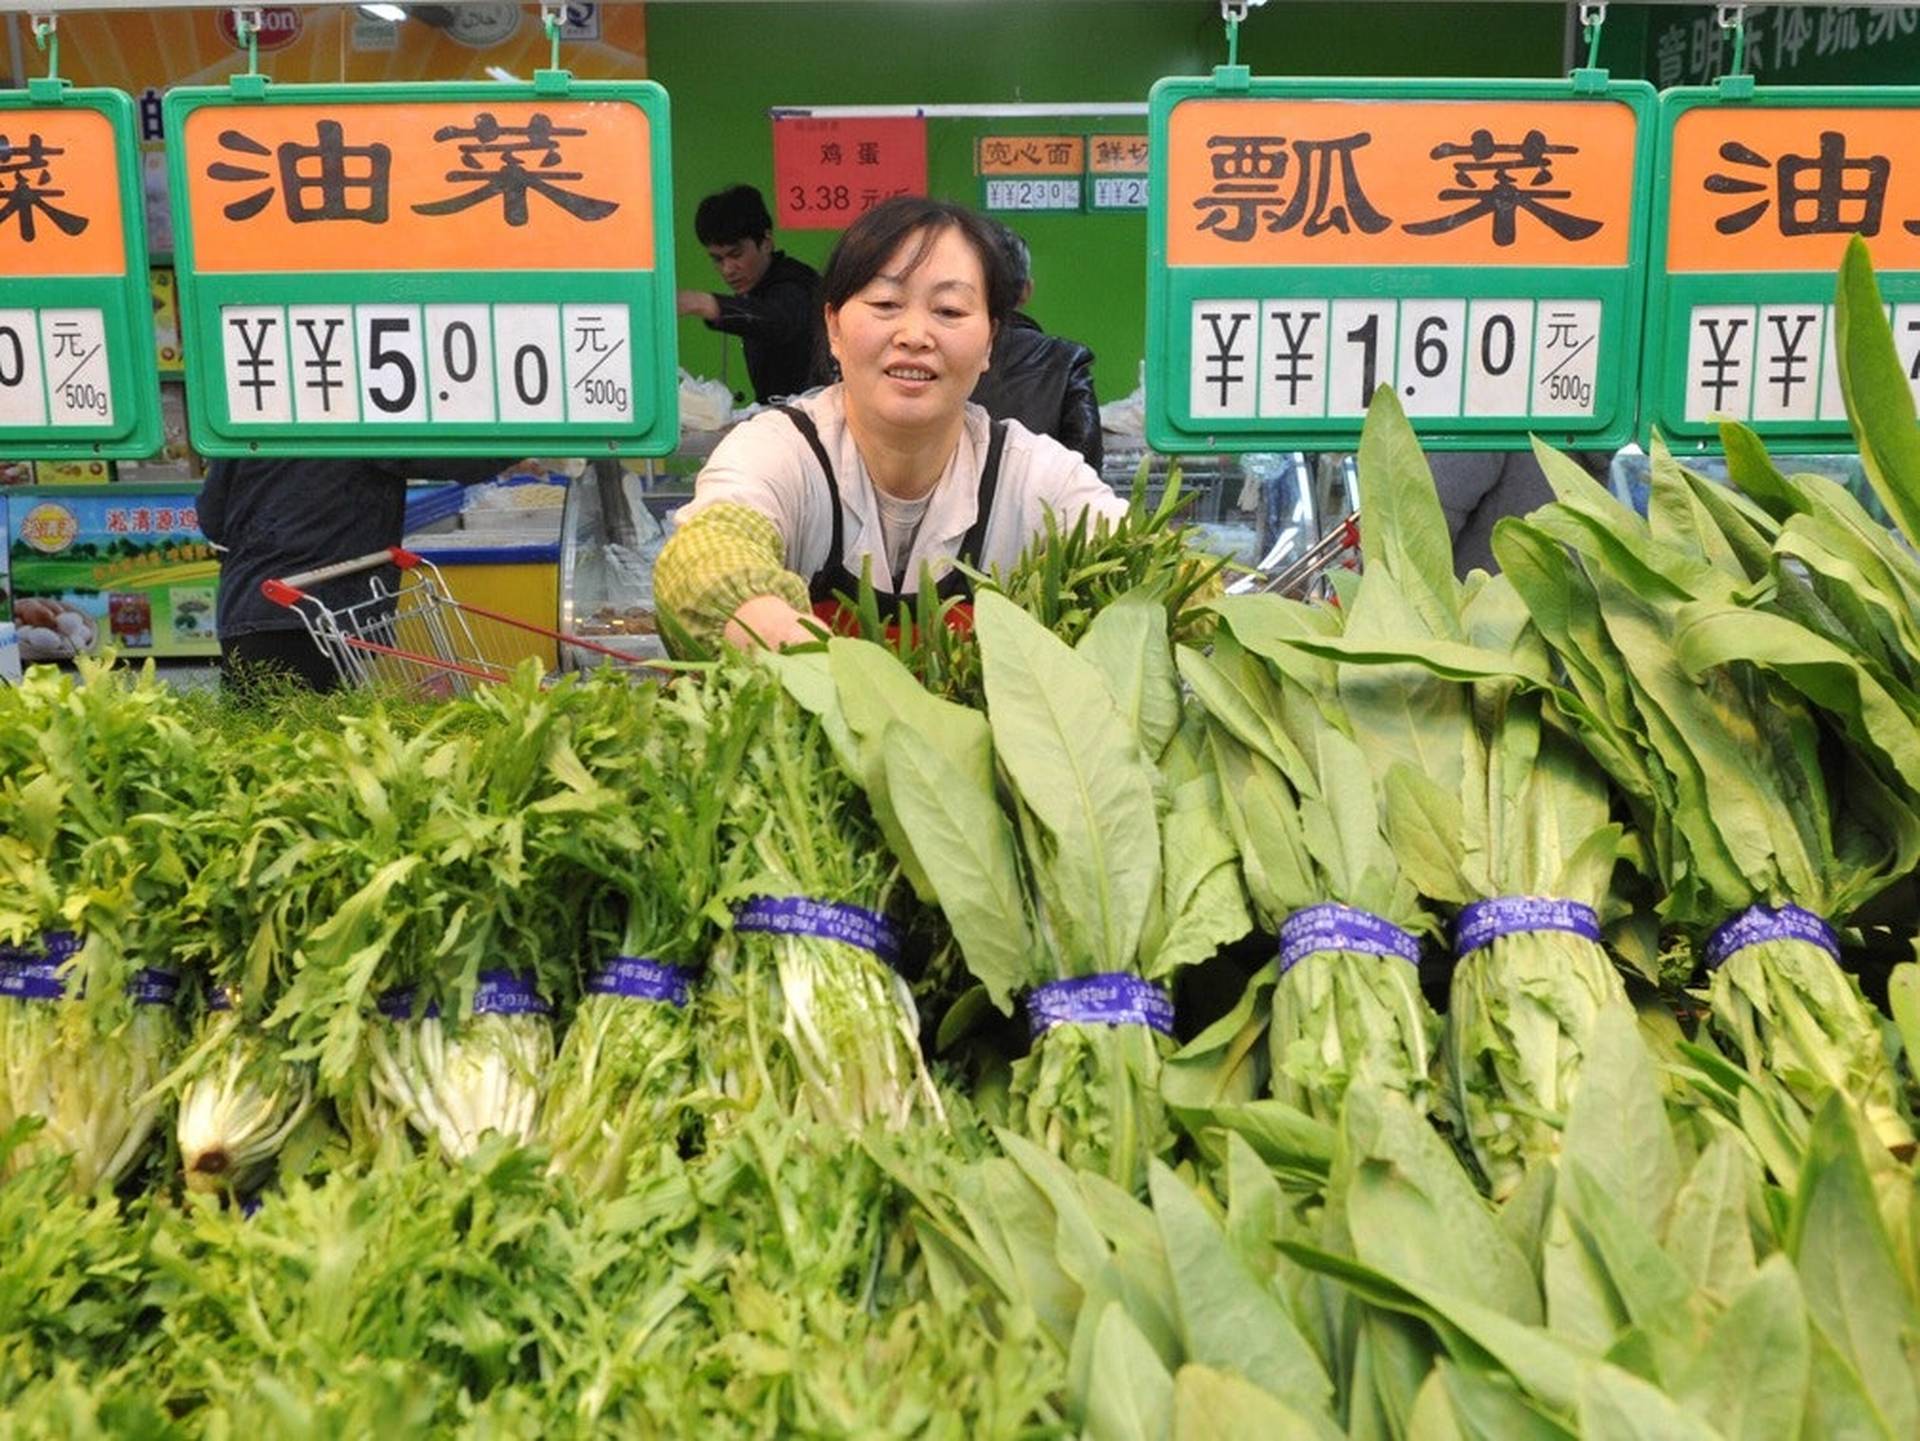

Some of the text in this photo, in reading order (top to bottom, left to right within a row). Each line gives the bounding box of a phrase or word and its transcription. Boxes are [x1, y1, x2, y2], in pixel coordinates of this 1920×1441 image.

[207, 113, 620, 226] 油菜
[790, 185, 850, 211] 3.38
[1194, 130, 1604, 246] 瓢菜
[1703, 131, 1920, 237] 油
